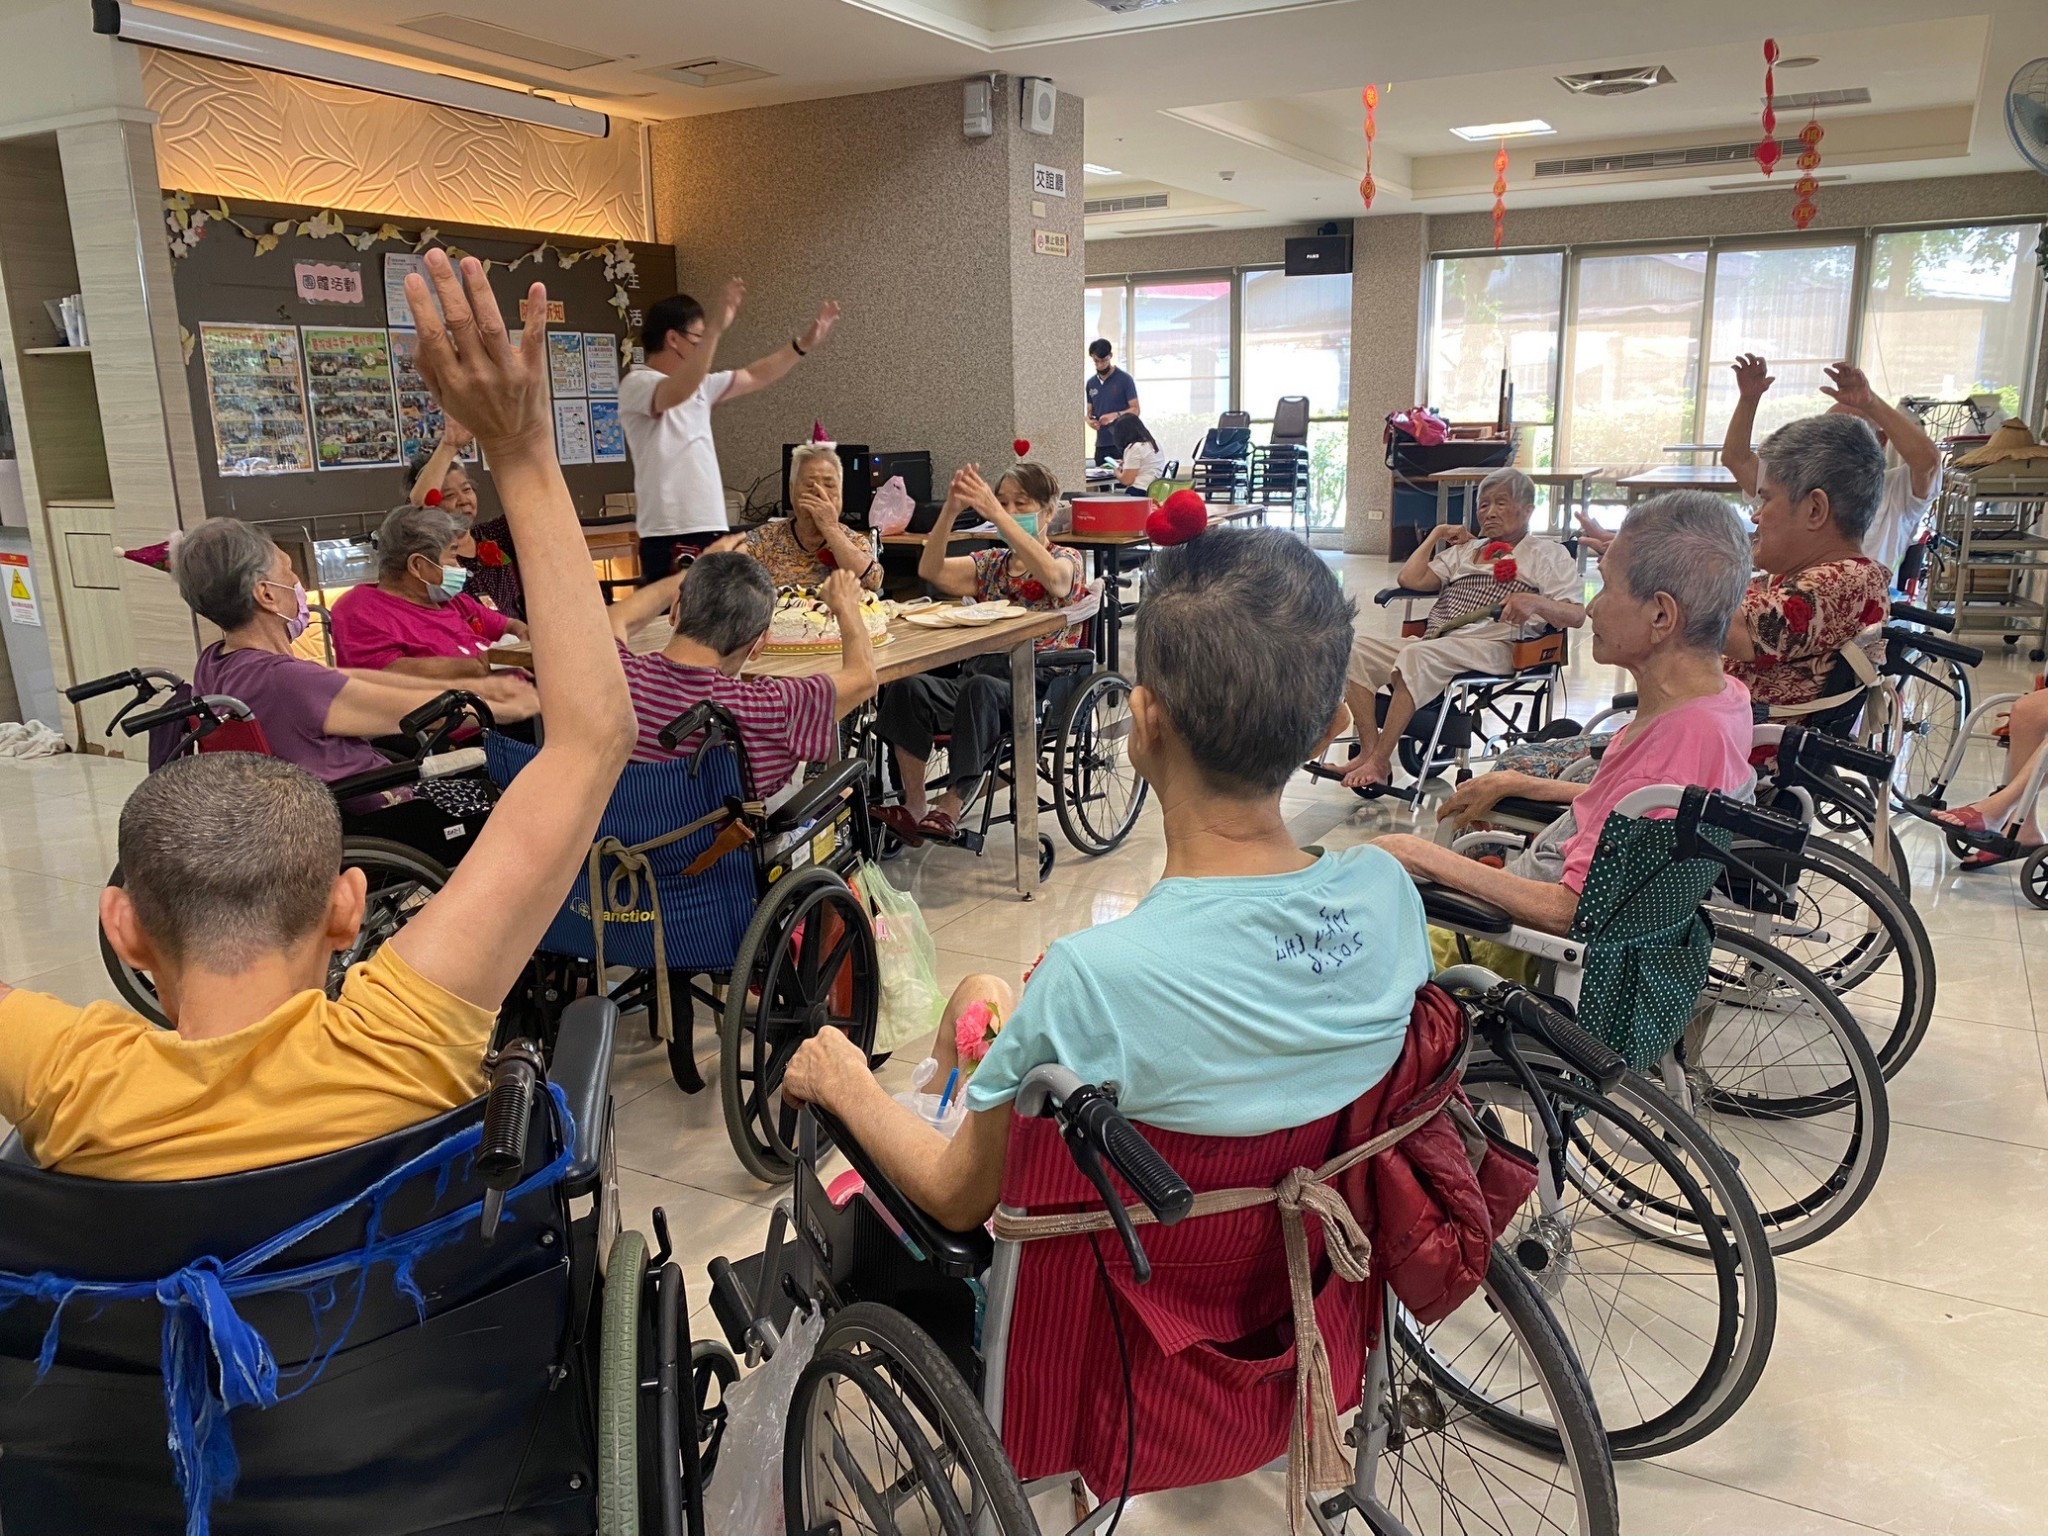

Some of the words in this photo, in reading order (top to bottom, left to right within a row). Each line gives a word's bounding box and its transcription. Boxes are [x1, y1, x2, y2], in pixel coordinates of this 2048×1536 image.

[1036, 170, 1064, 192] 交誼廳
[302, 275, 357, 293] 團體活動
